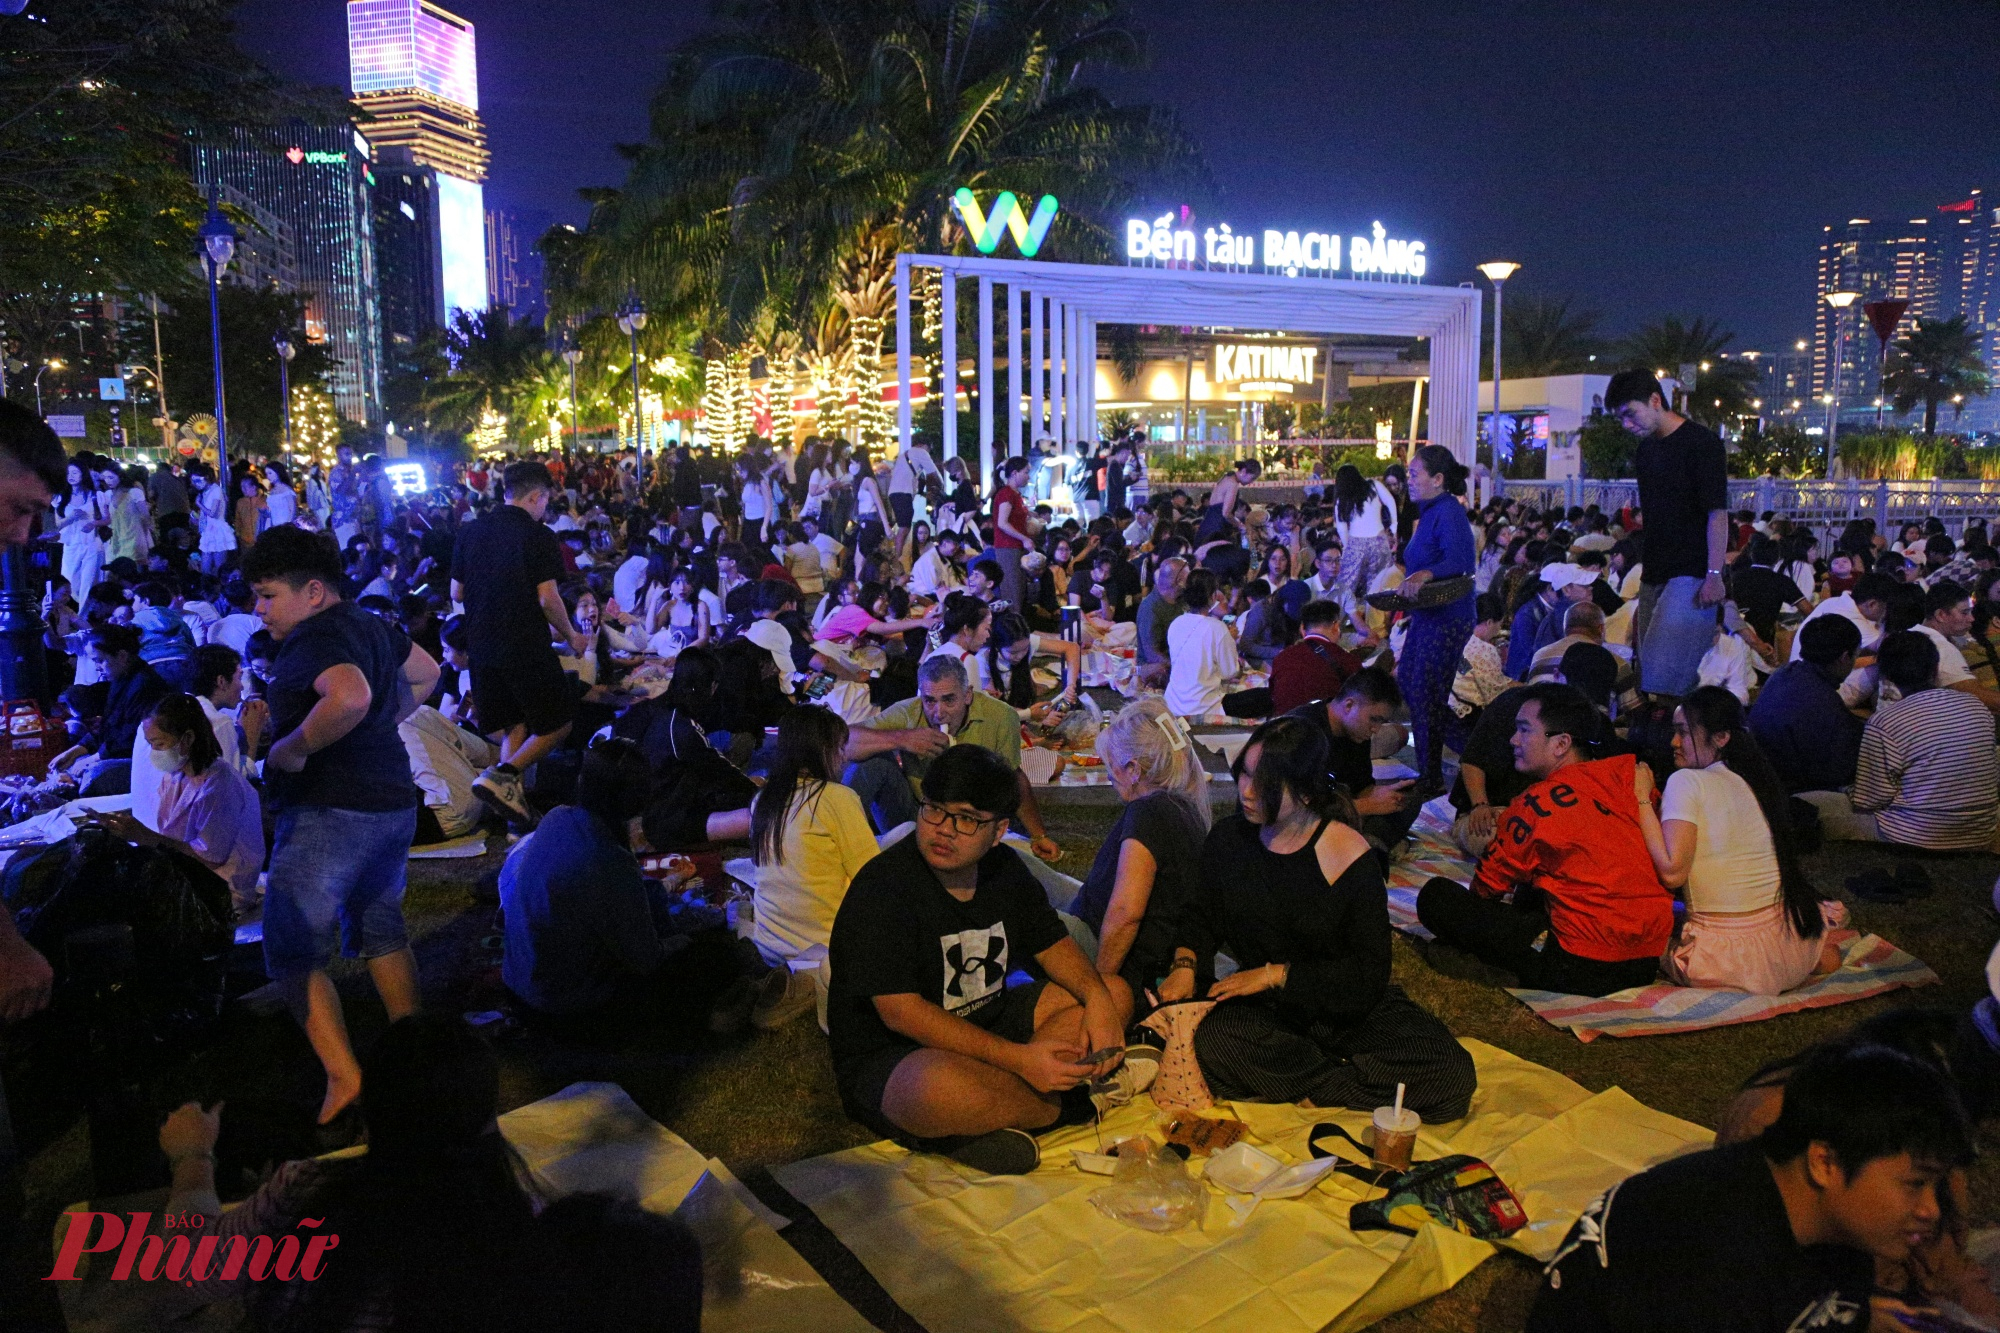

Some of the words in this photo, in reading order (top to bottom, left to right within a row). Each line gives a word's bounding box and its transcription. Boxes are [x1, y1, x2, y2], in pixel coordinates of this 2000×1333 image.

[304, 152, 347, 164] VPBank
[1127, 212, 1196, 261] Bến
[1204, 222, 1253, 265] tàu
[1264, 230, 1341, 278] BẠCH
[1350, 220, 1426, 277] ĐẰNG
[1215, 344, 1318, 384] KATINAT
